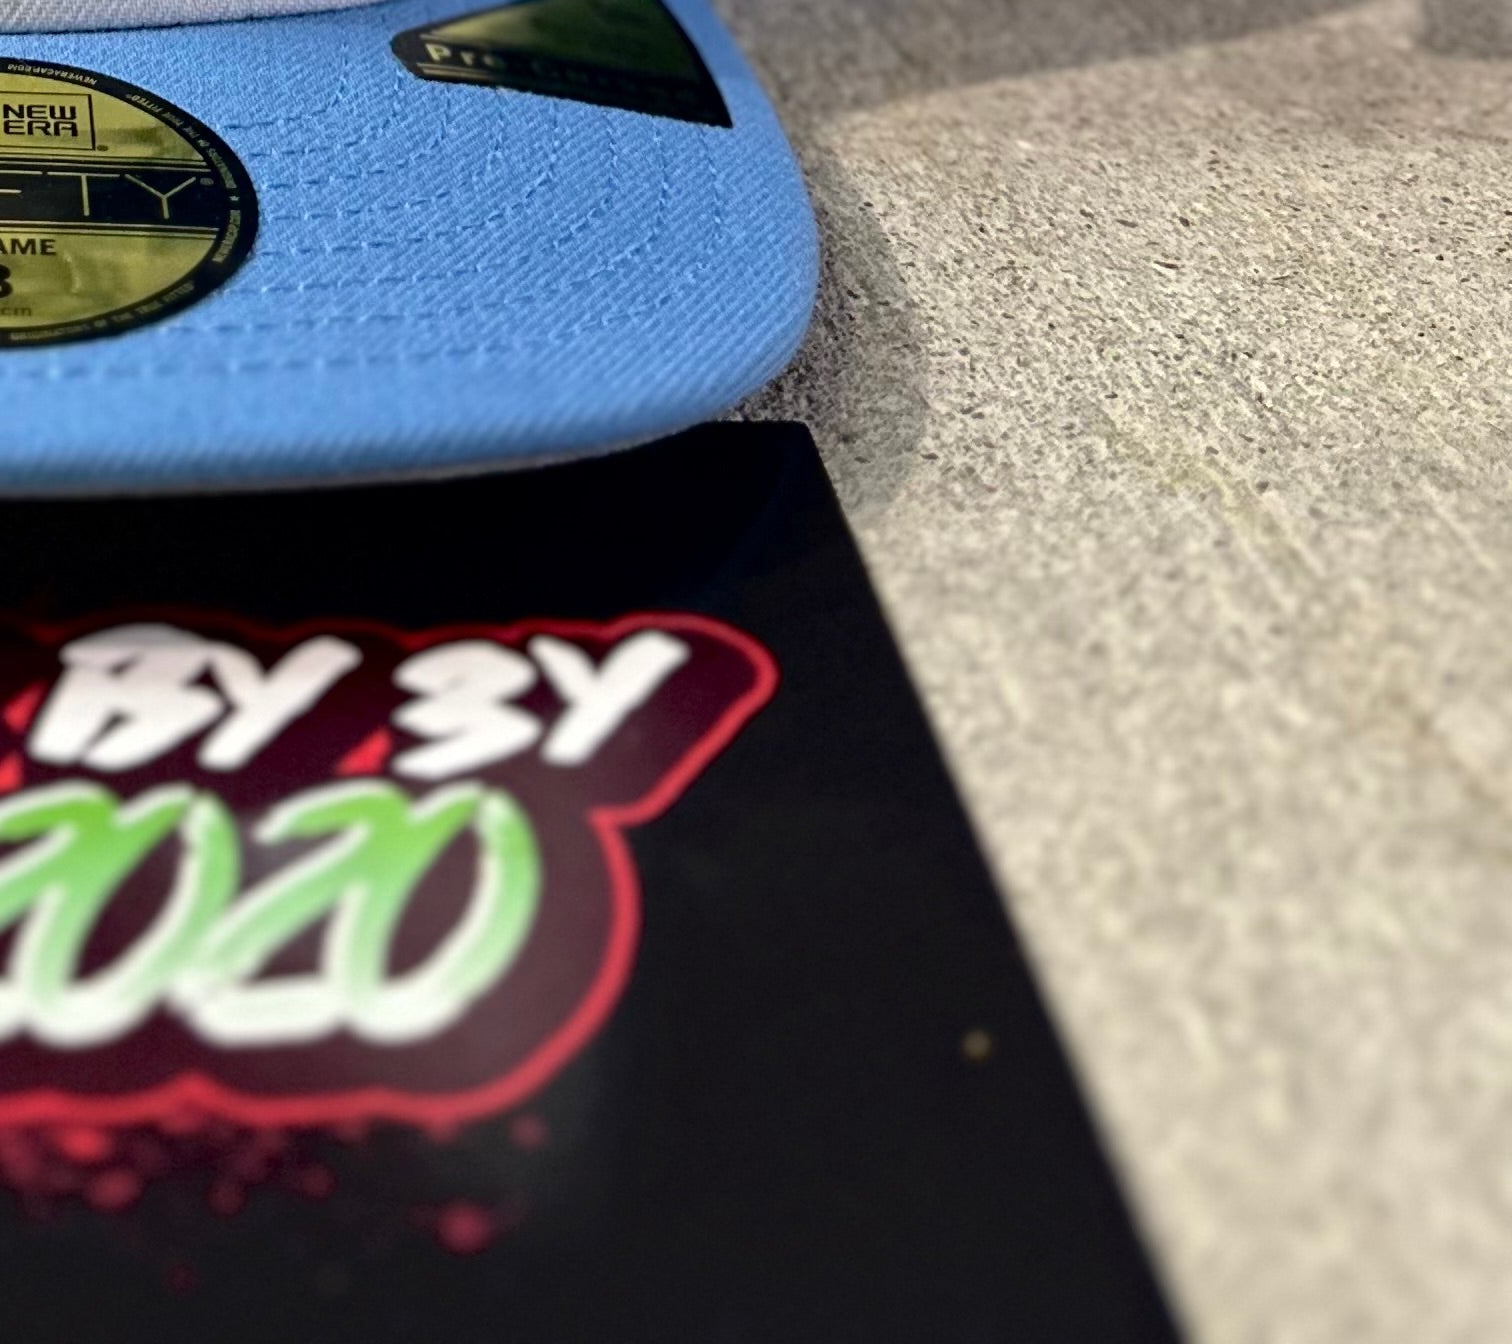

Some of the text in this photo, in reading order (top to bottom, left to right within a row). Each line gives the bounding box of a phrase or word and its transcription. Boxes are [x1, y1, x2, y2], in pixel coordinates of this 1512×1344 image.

[2, 103, 77, 121] NEW
[3, 119, 79, 138] ERA
[27, 622, 364, 772] BY
